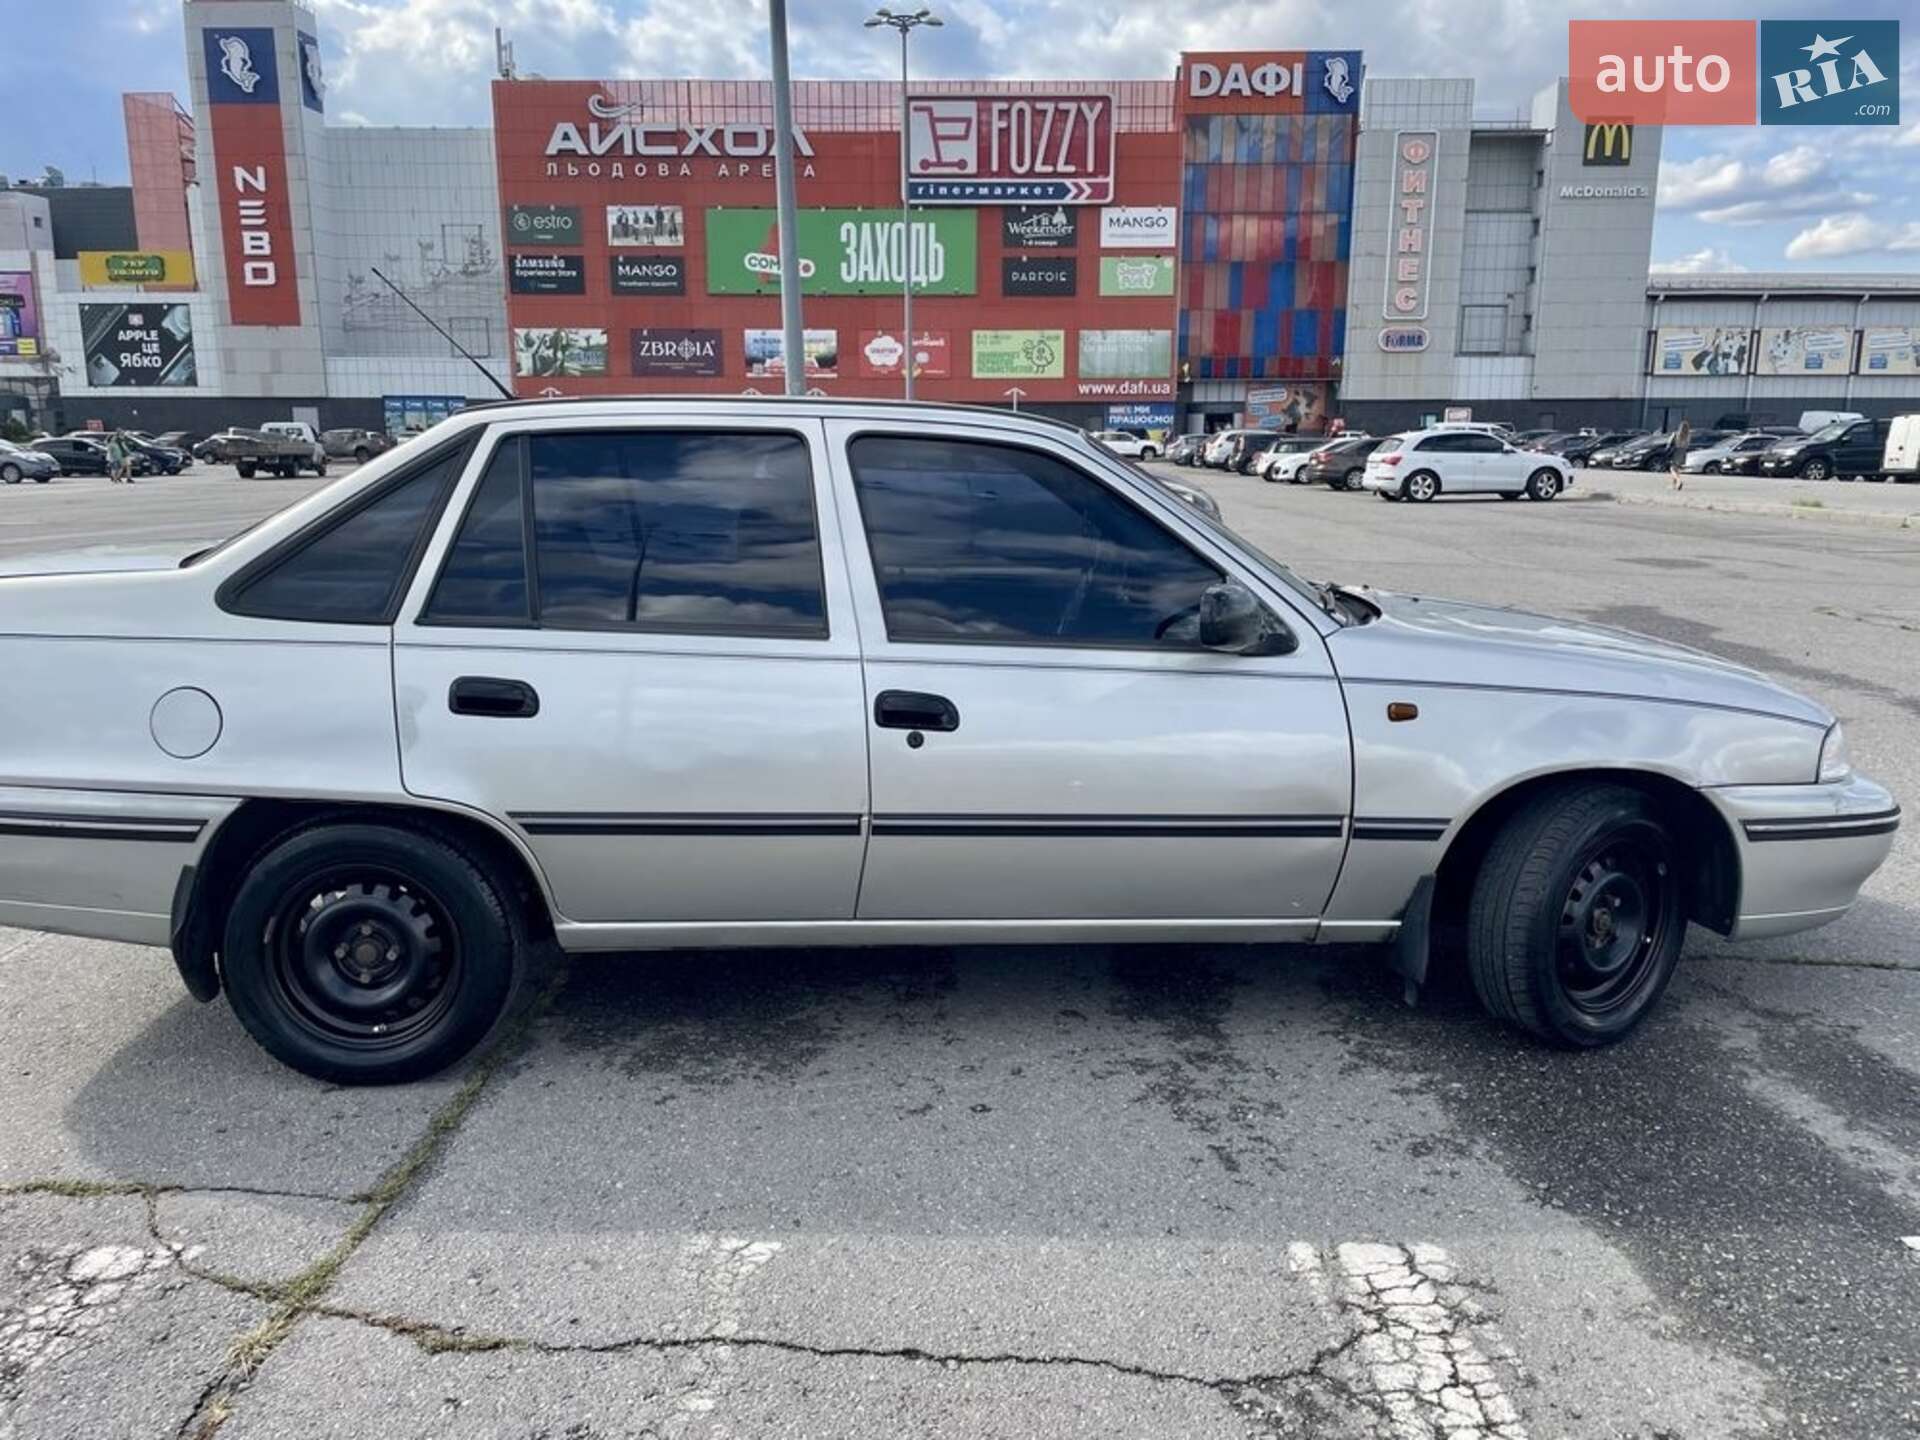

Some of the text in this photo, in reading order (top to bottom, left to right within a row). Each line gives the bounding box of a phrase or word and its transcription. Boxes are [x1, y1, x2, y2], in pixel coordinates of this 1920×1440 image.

[990, 100, 1103, 174] FOZZY
[546, 163, 815, 178] ЛЬОДОВА АРЕА
[1560, 185, 1648, 198] McDonald's
[533, 215, 573, 229] estro
[1008, 220, 1075, 236] Weekender
[1109, 216, 1168, 228] MANGO
[1395, 139, 1430, 312] ФИТНЕС
[840, 222, 944, 287] ЗАХОДЬ
[515, 259, 565, 268] SAMSUNG
[515, 269, 556, 277] Experience
[618, 264, 677, 277] MANGO
[118, 330, 159, 341] APPLE
[142, 343, 160, 354] ЦЕ
[1078, 382, 1171, 395] www.dafi.ua
